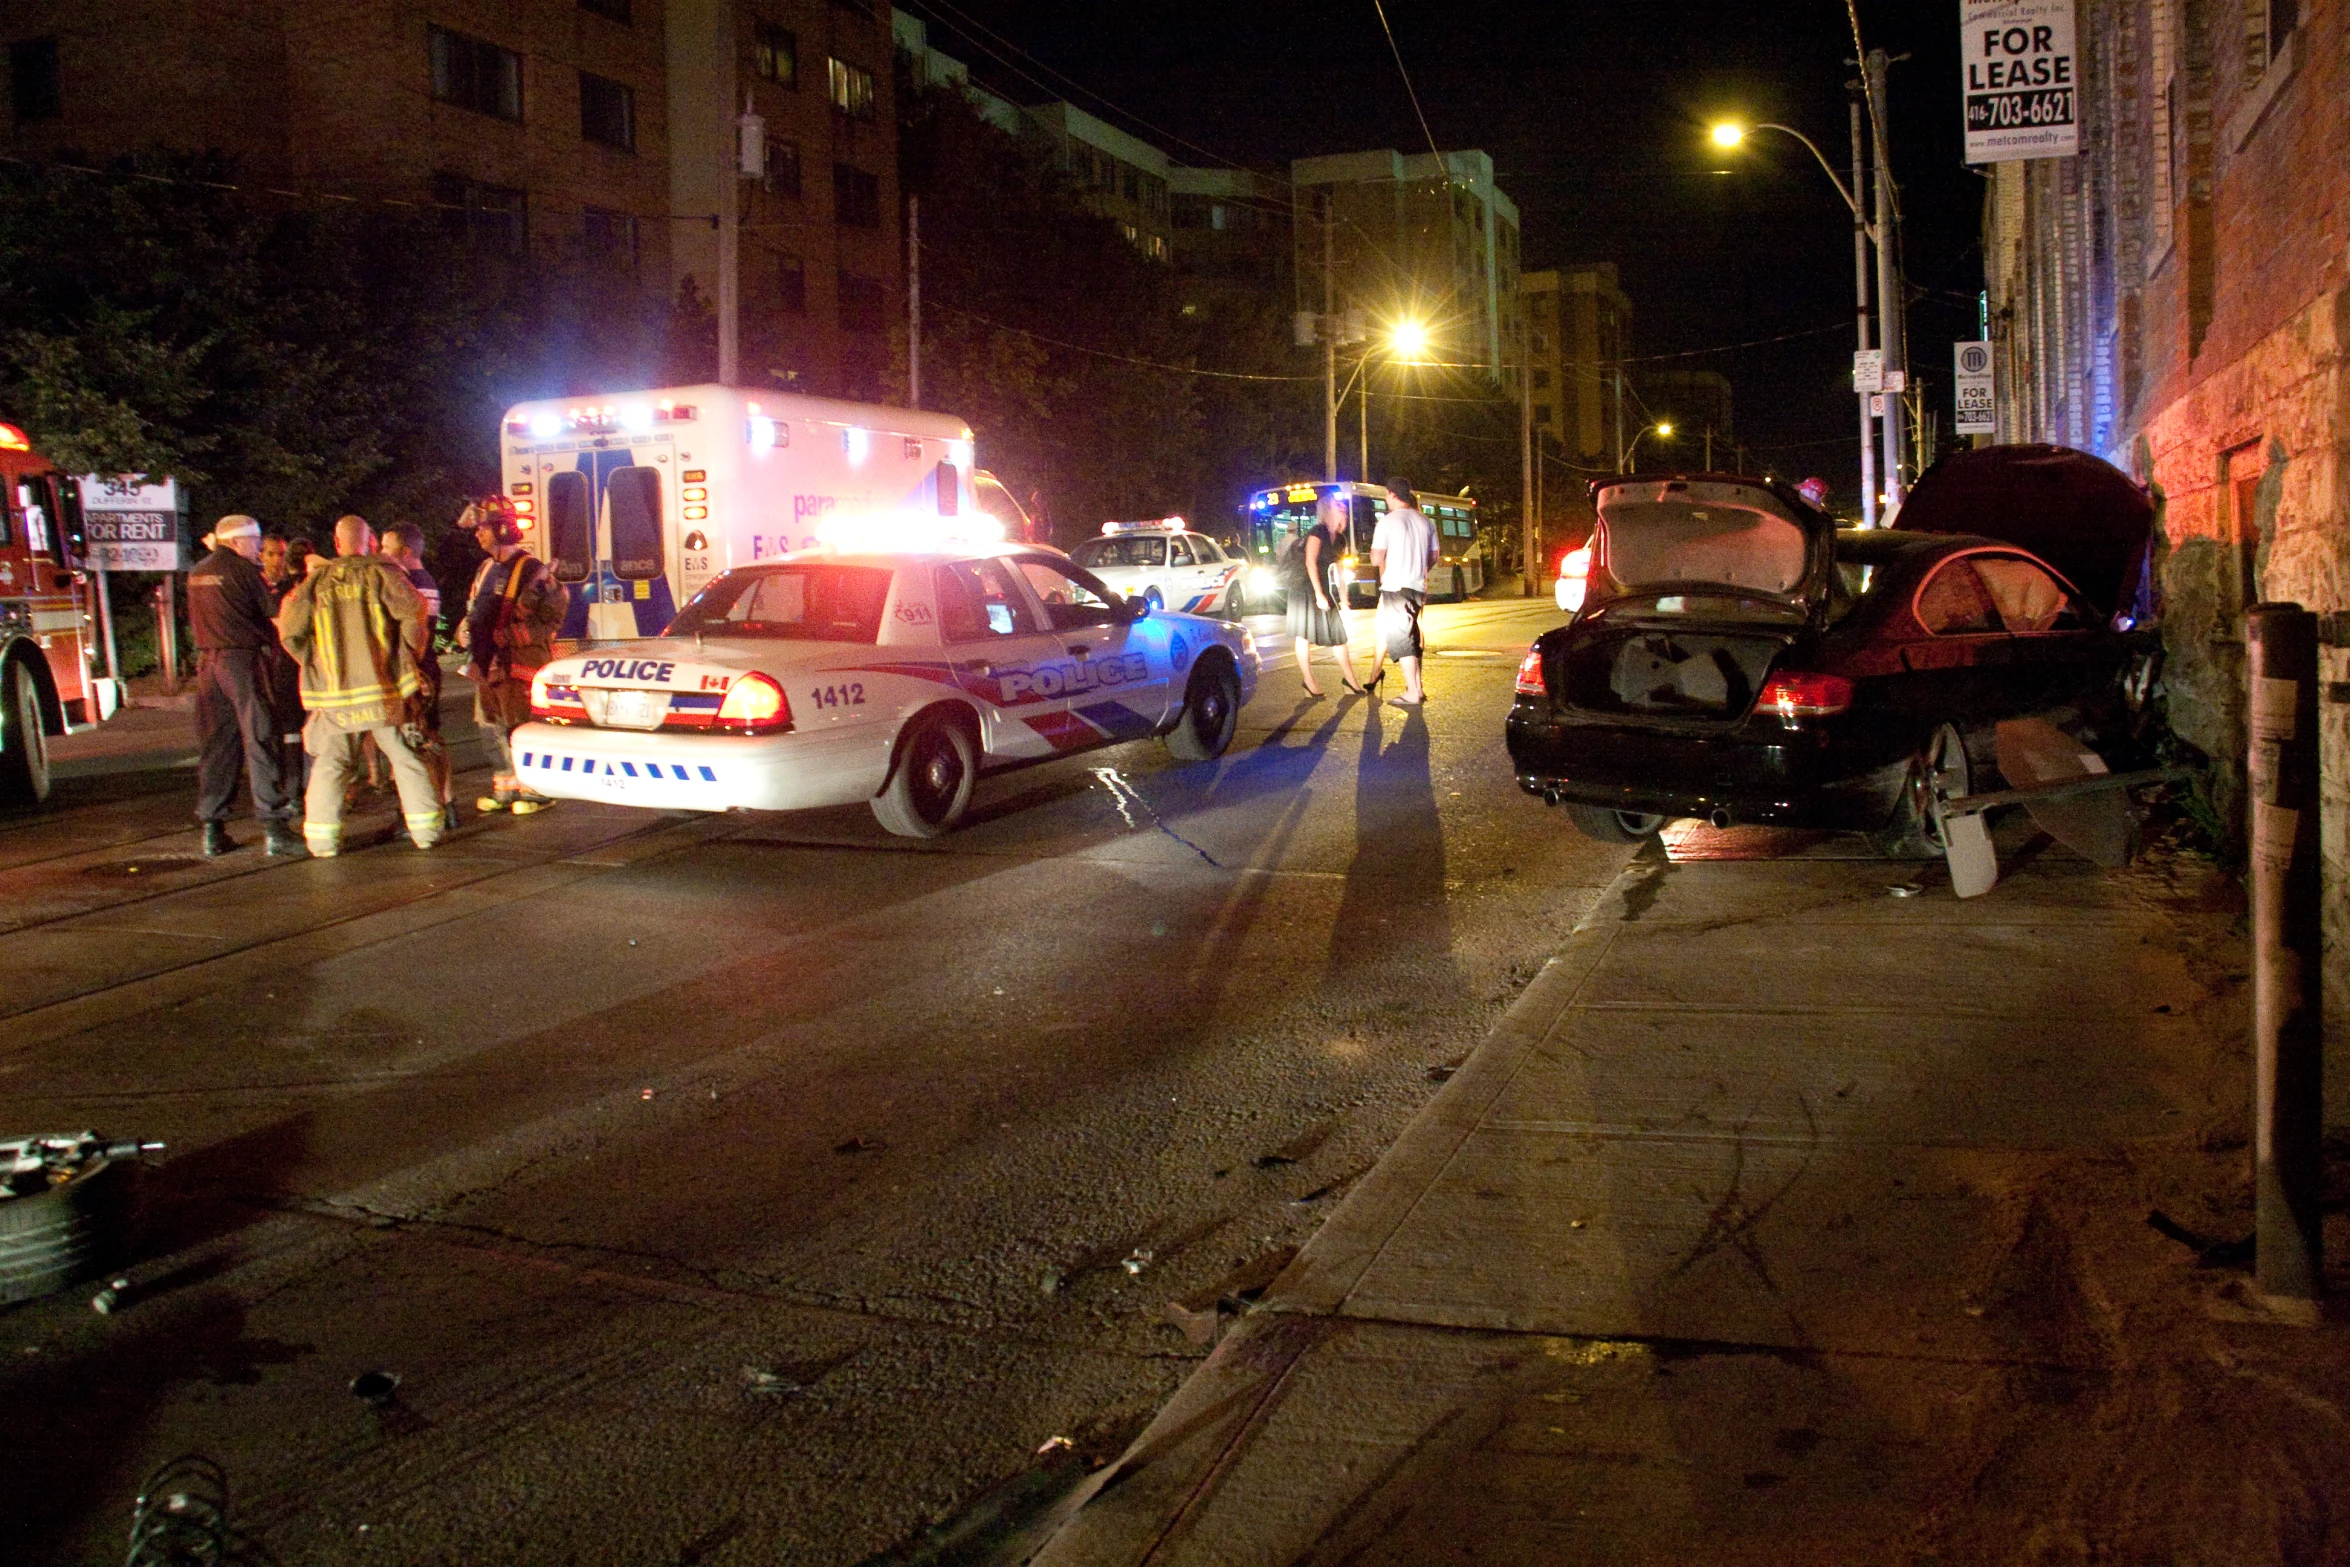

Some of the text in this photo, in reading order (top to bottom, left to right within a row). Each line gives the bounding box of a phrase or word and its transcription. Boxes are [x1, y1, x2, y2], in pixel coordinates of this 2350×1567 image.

[1984, 26, 2053, 57] FOR
[1969, 56, 2071, 90] LEASE
[1968, 92, 2074, 126] 416-703-6621
[1958, 398, 1992, 409] LEASE
[1963, 388, 1987, 398] FOR
[104, 478, 141, 496] 345
[87, 523, 166, 539] FOR RENT
[580, 659, 676, 684] POLICE
[998, 652, 1149, 701] POLICE
[811, 683, 865, 709] 1412
[336, 712, 347, 727] S
[601, 778, 626, 789] 1412
